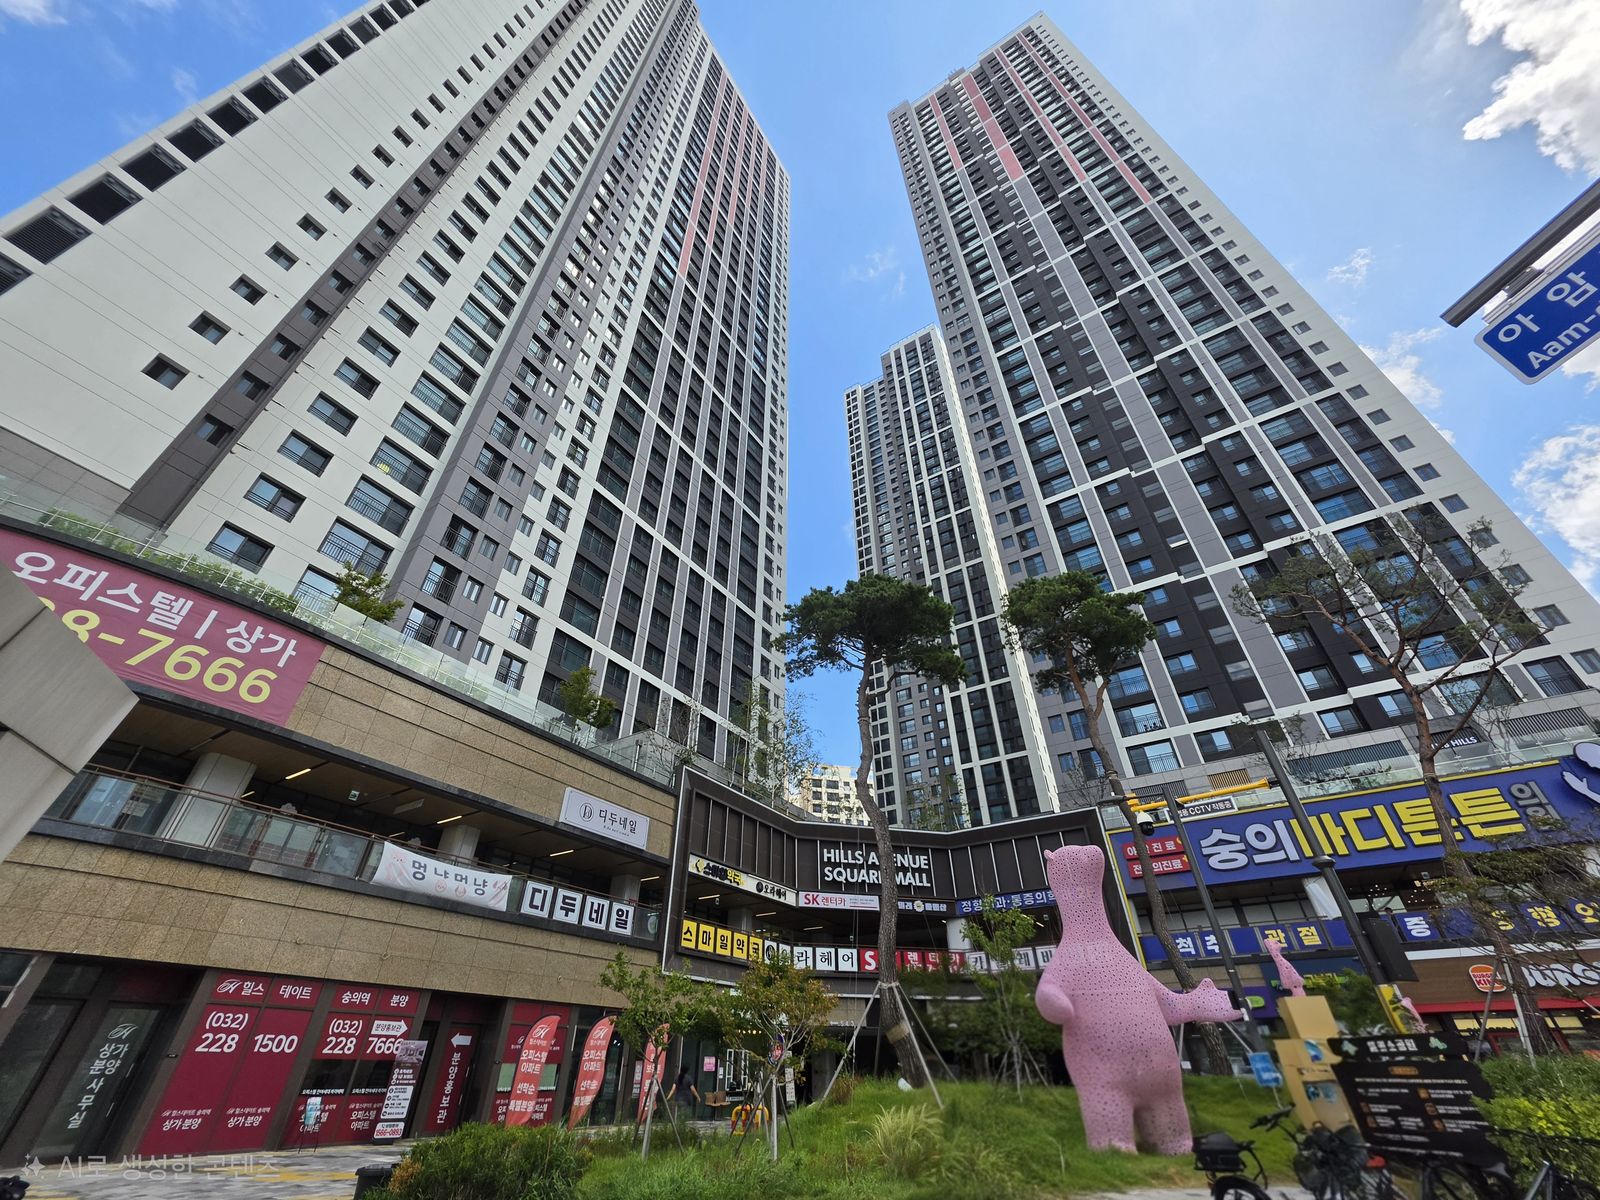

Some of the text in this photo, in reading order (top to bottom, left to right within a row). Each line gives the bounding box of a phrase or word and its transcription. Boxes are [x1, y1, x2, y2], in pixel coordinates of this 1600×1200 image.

[11, 551, 195, 631] 오피스텔
[225, 620, 297, 668] 상가
[38, 596, 278, 704] 8-7666
[1188, 804, 1212, 816] CCTV
[599, 809, 637, 834] 디두네일
[1126, 840, 1177, 856] 야진료
[823, 848, 864, 865] HILLS
[1133, 859, 1183, 876] 전의진료
[527, 886, 632, 929] 디두네일
[803, 893, 821, 906] SK
[821, 896, 846, 907] 렌터카
[1263, 925, 1322, 948] 관절
[279, 984, 313, 999] 테이트
[341, 991, 409, 1008] 숭의역 분양
[205, 1011, 249, 1031] (032)
[328, 1018, 363, 1036] (032)
[100, 1043, 129, 1058] 상가
[195, 1033, 299, 1054] 228 1500
[322, 1036, 357, 1055] 228
[366, 1037, 403, 1055] 7666
[520, 1050, 548, 1062] 오피스텔
[89, 1059, 121, 1075] 분양
[520, 1062, 541, 1073] 아파트
[516, 1082, 535, 1095] 선착순
[227, 1115, 262, 1128] 상가 분양
[350, 1110, 377, 1120] 오피스텔
[162, 1118, 202, 1131] 상가 분양
[350, 1121, 370, 1131] 아파트
